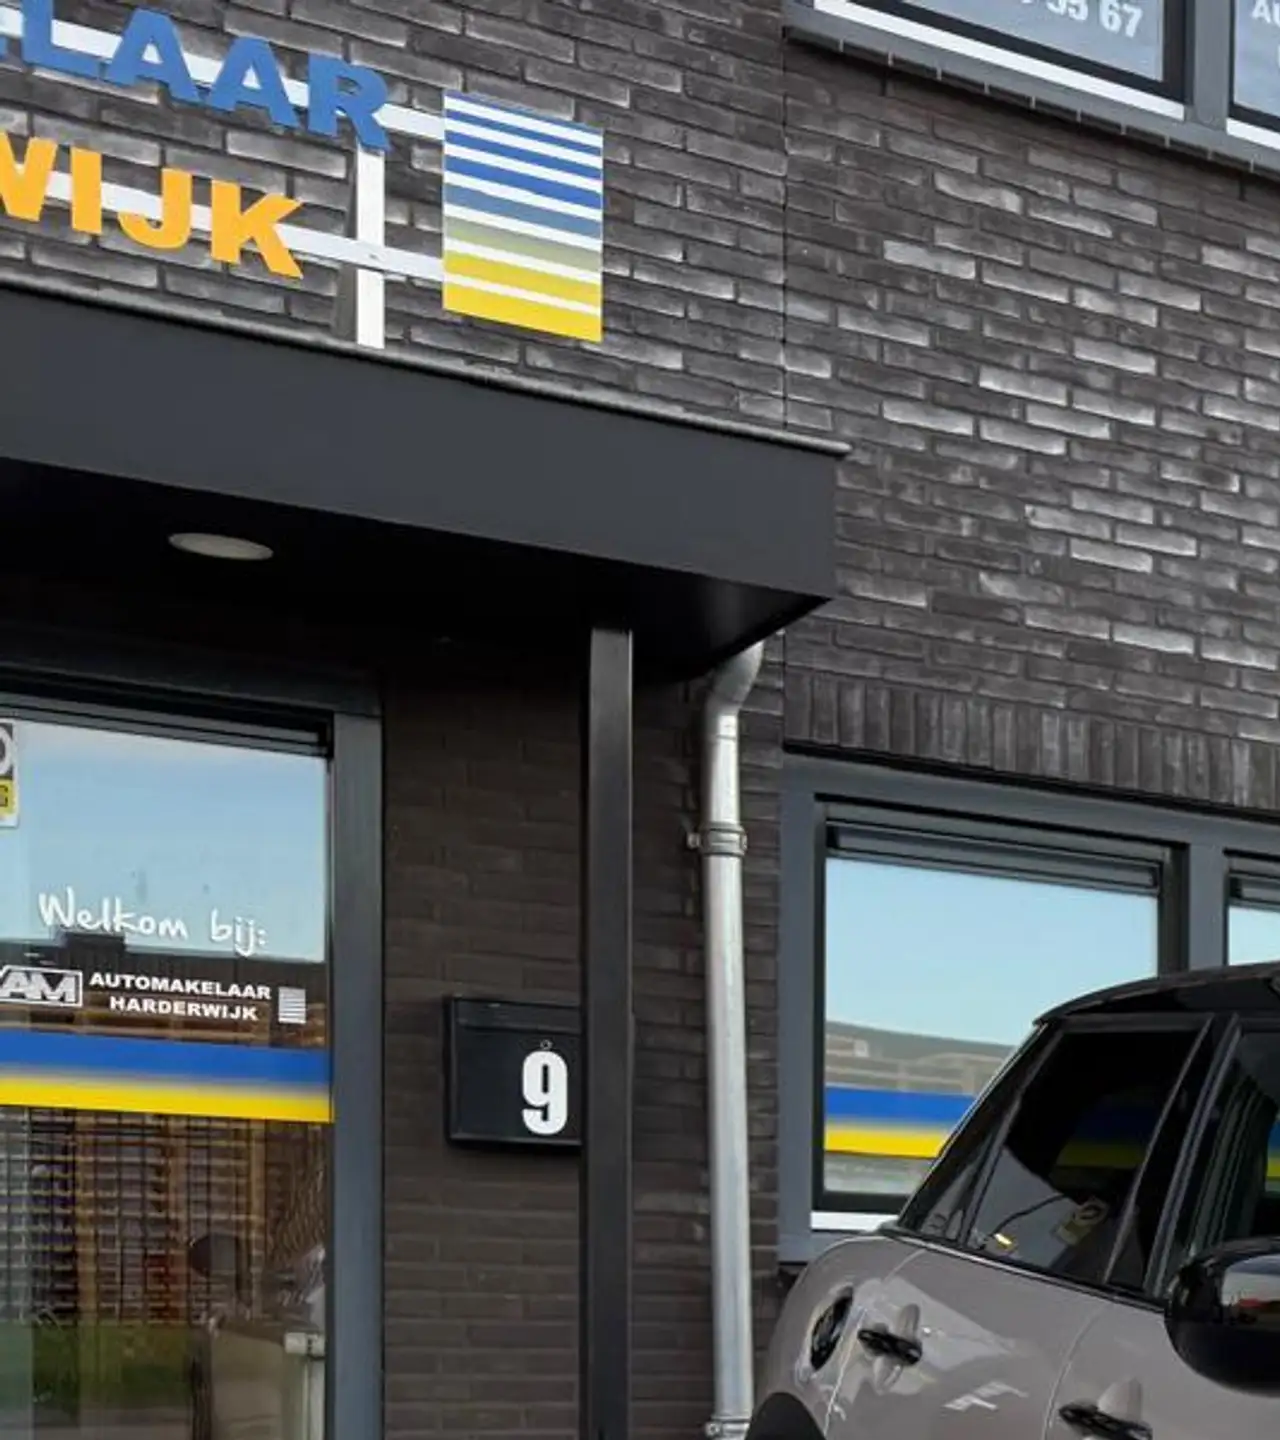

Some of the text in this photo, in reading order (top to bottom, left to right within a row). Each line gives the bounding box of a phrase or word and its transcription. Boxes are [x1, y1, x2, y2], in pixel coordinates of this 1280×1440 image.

[0, 0, 390, 151] LAAR
[38, 886, 268, 957] Welkom bij:
[89, 971, 272, 1000] AUTOMAKELAAR
[109, 996, 259, 1021] HARDERWIJK
[522, 1050, 568, 1134] 9
